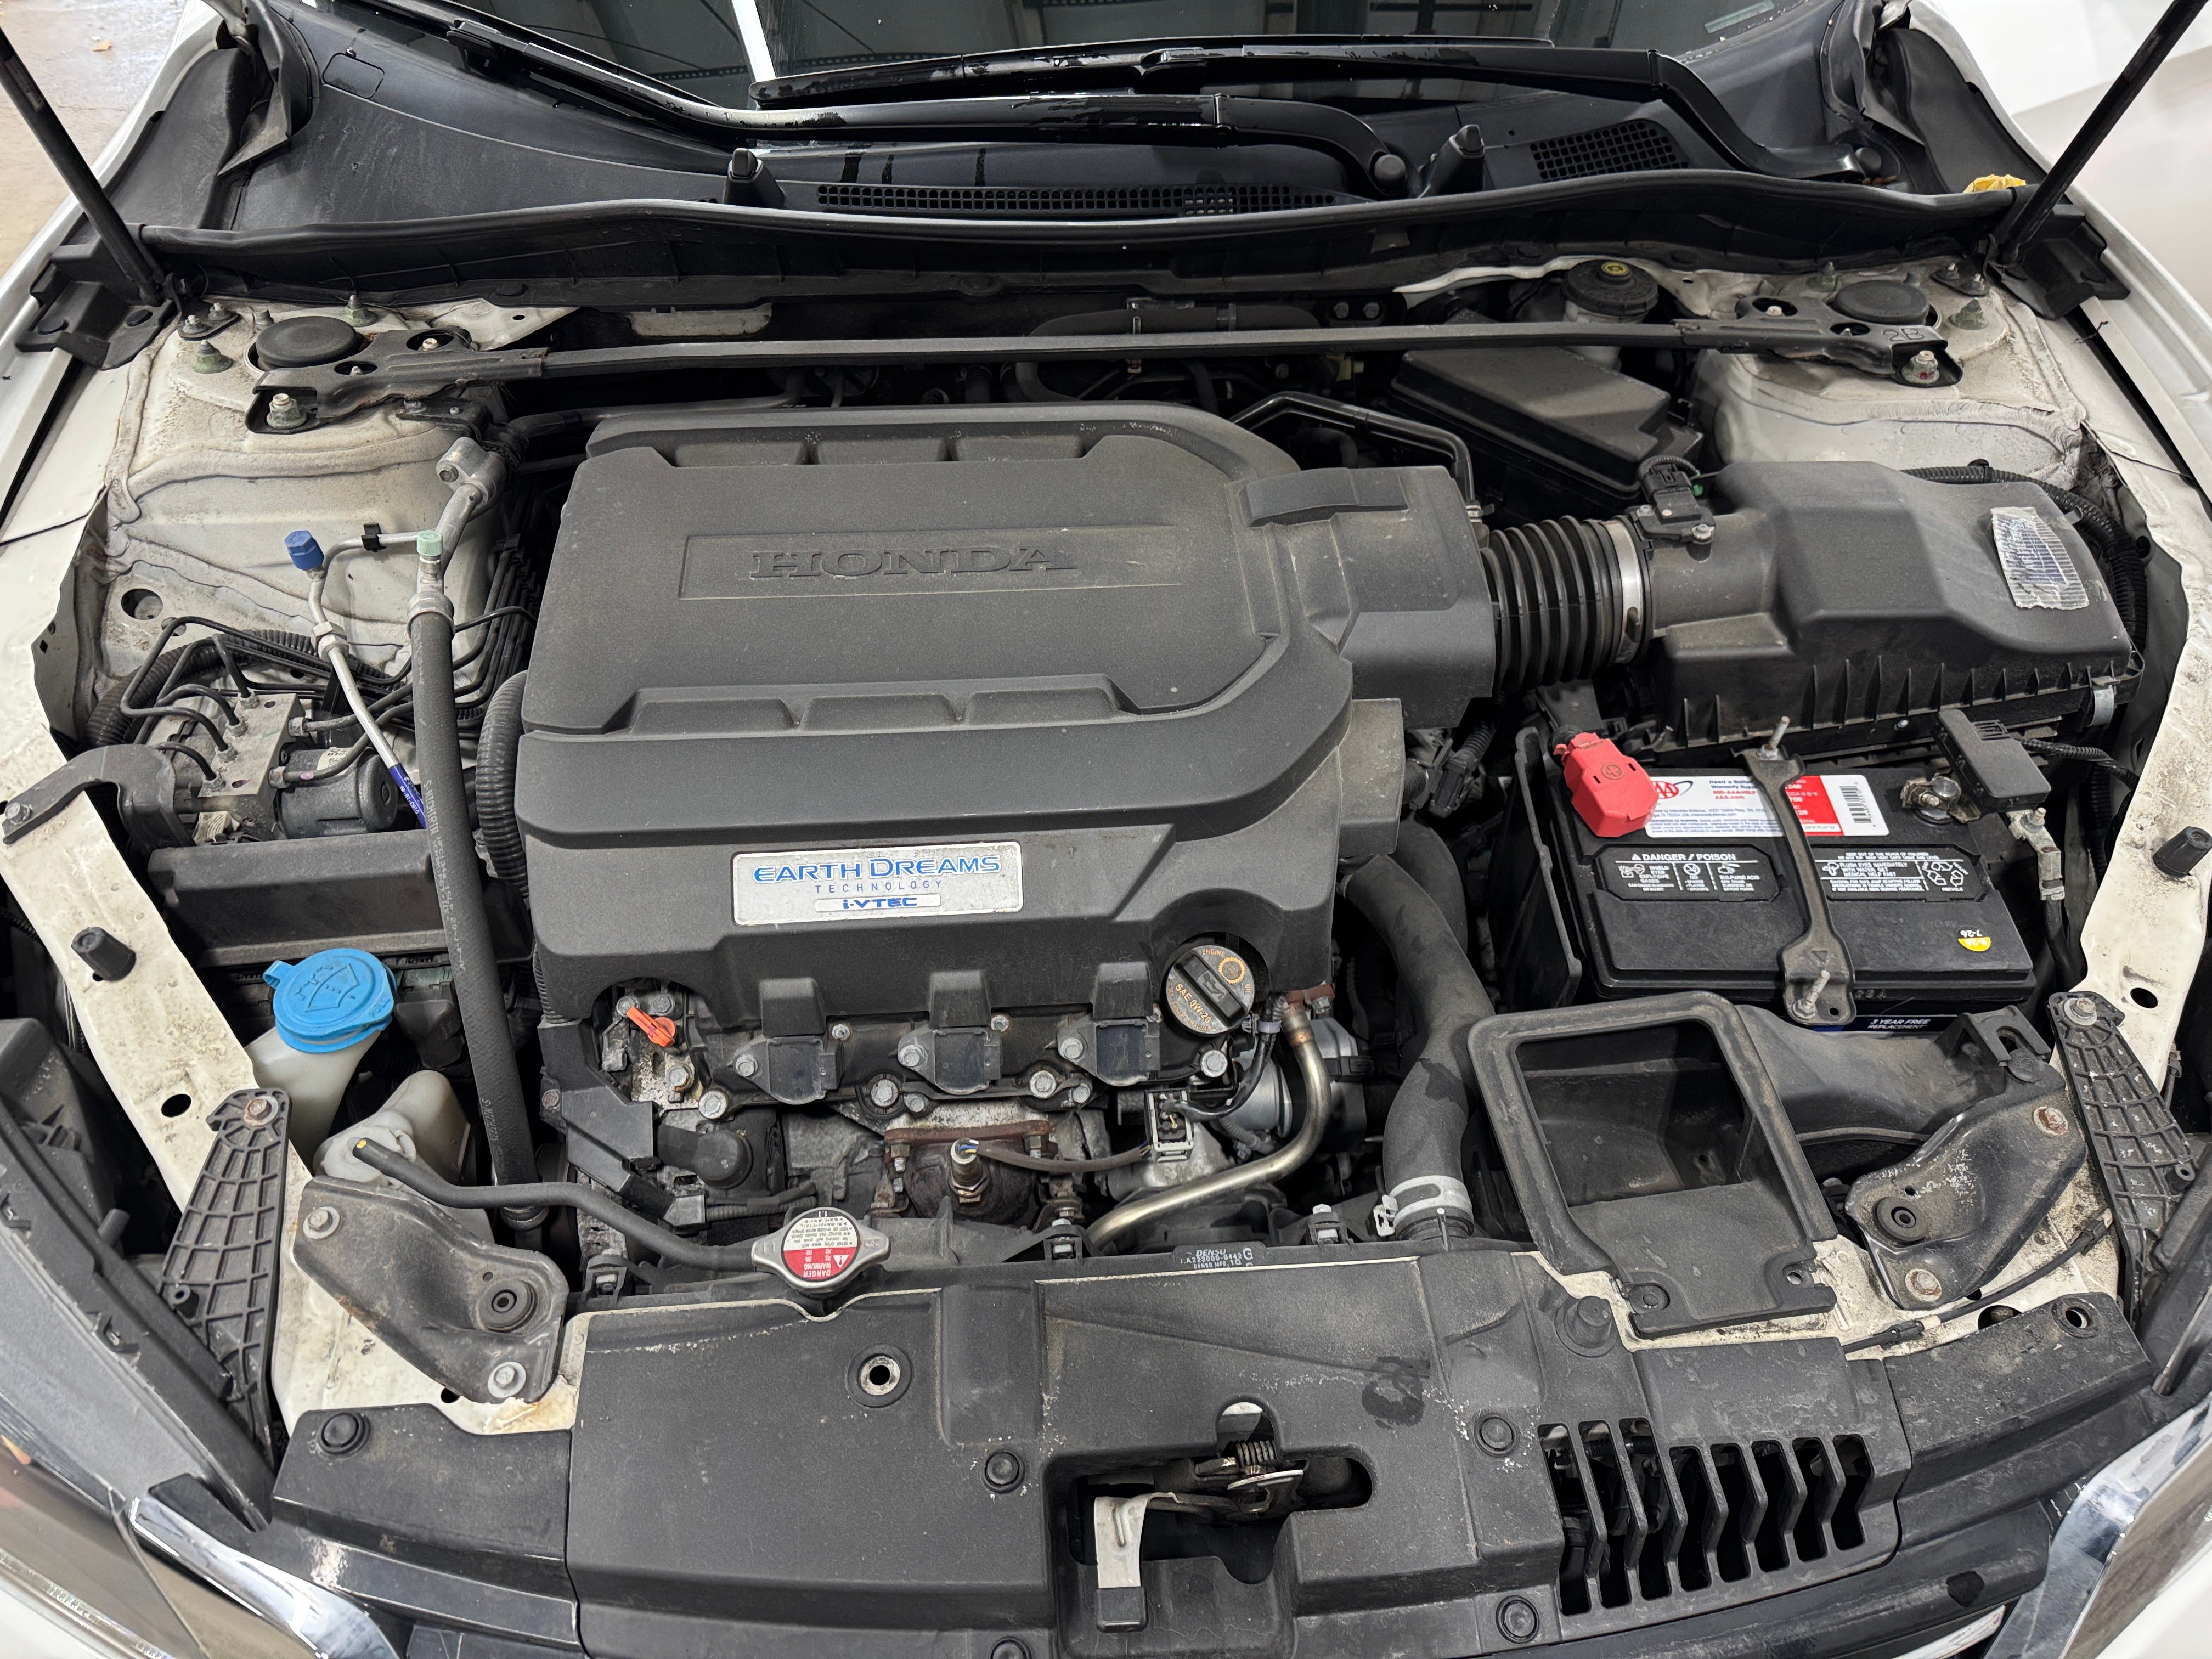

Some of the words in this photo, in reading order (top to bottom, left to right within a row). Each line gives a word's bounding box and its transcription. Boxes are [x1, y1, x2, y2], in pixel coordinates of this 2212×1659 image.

[751, 547, 1077, 579] HONDA
[753, 862, 861, 884] EARTH
[868, 854, 1002, 879] DREAMS
[815, 879, 943, 894] TECHNOLOGY
[843, 897, 917, 910] i-VTEC
[1202, 949, 1226, 957] ENGINE
[1175, 983, 1193, 1001] SAE
[1196, 1248, 1226, 1257] DENSO
[1243, 1247, 1254, 1261] G
[804, 1262, 831, 1271] WARNUNG
[803, 1269, 831, 1278] DANGER
